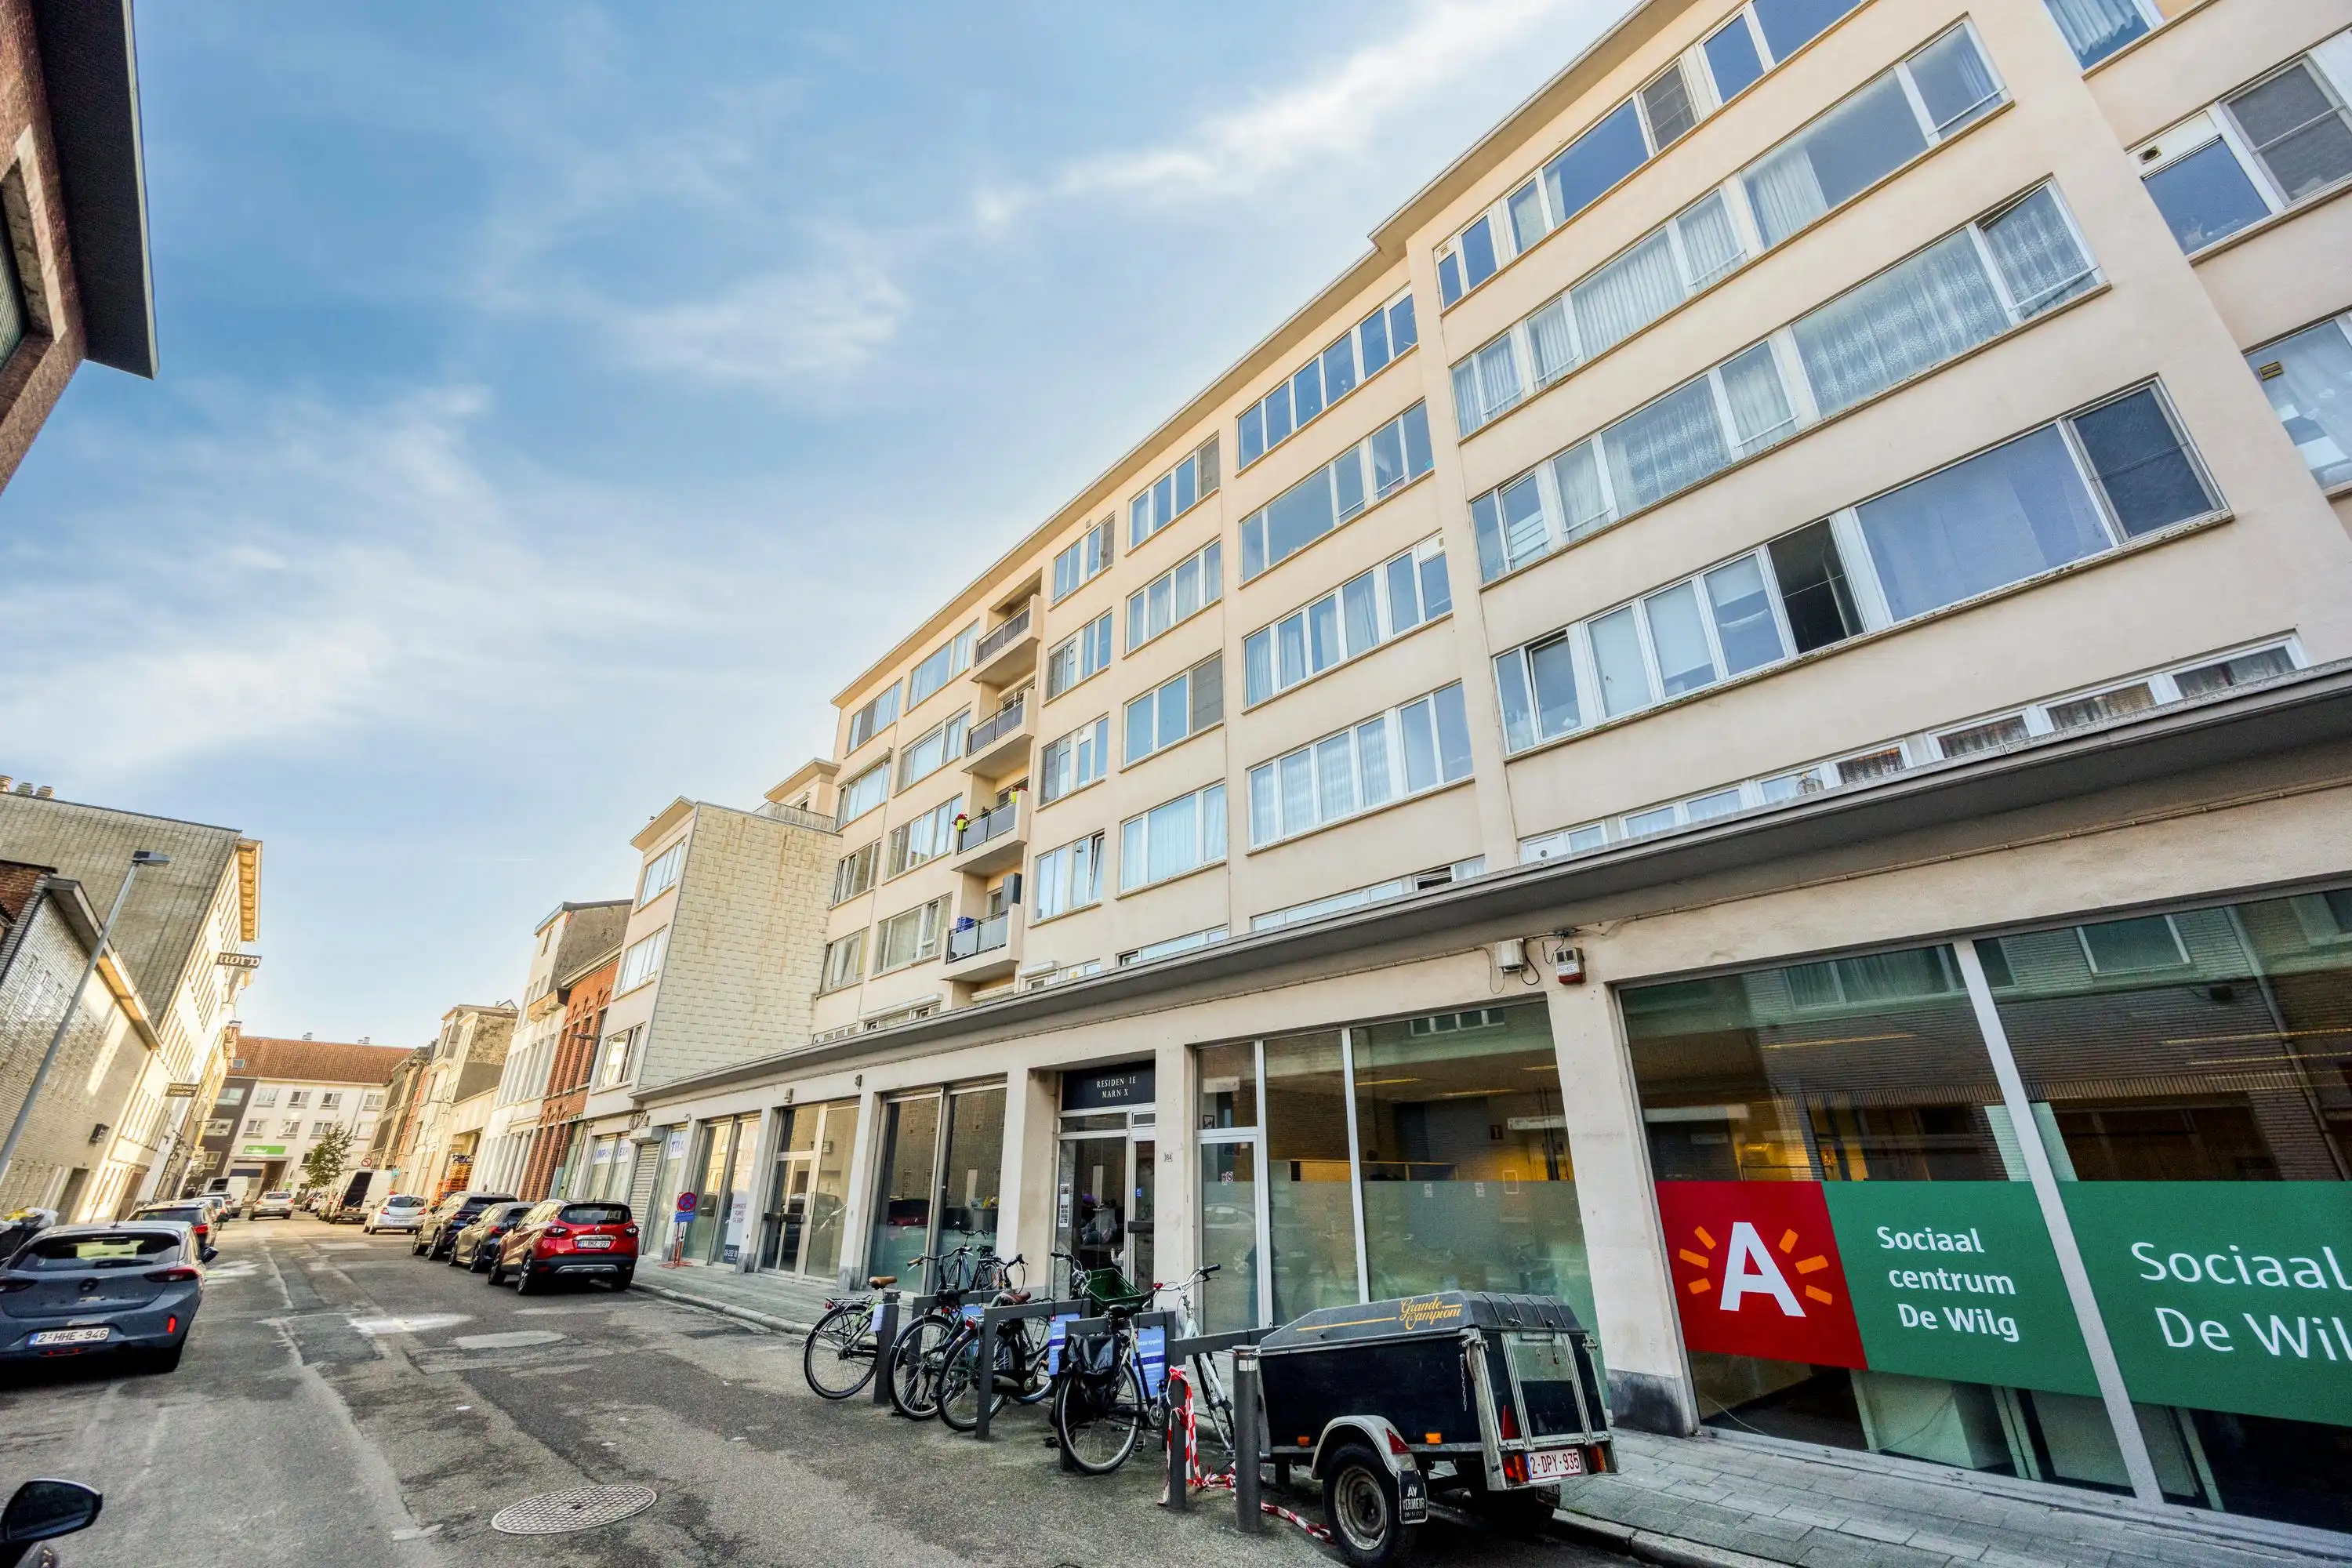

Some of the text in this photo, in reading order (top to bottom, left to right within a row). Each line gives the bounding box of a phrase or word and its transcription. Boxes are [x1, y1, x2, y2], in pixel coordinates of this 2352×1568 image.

[1876, 1226, 1985, 1253] Sociaal
[1720, 1221, 1806, 1318] A
[1889, 1267, 2016, 1295] centrum
[2131, 1242, 2352, 1290] Sociaal
[1399, 1296, 1443, 1321] Grande
[1405, 1308, 1462, 1330] Campioni
[1897, 1303, 2020, 1343] De Wilg
[2154, 1306, 2234, 1352] De
